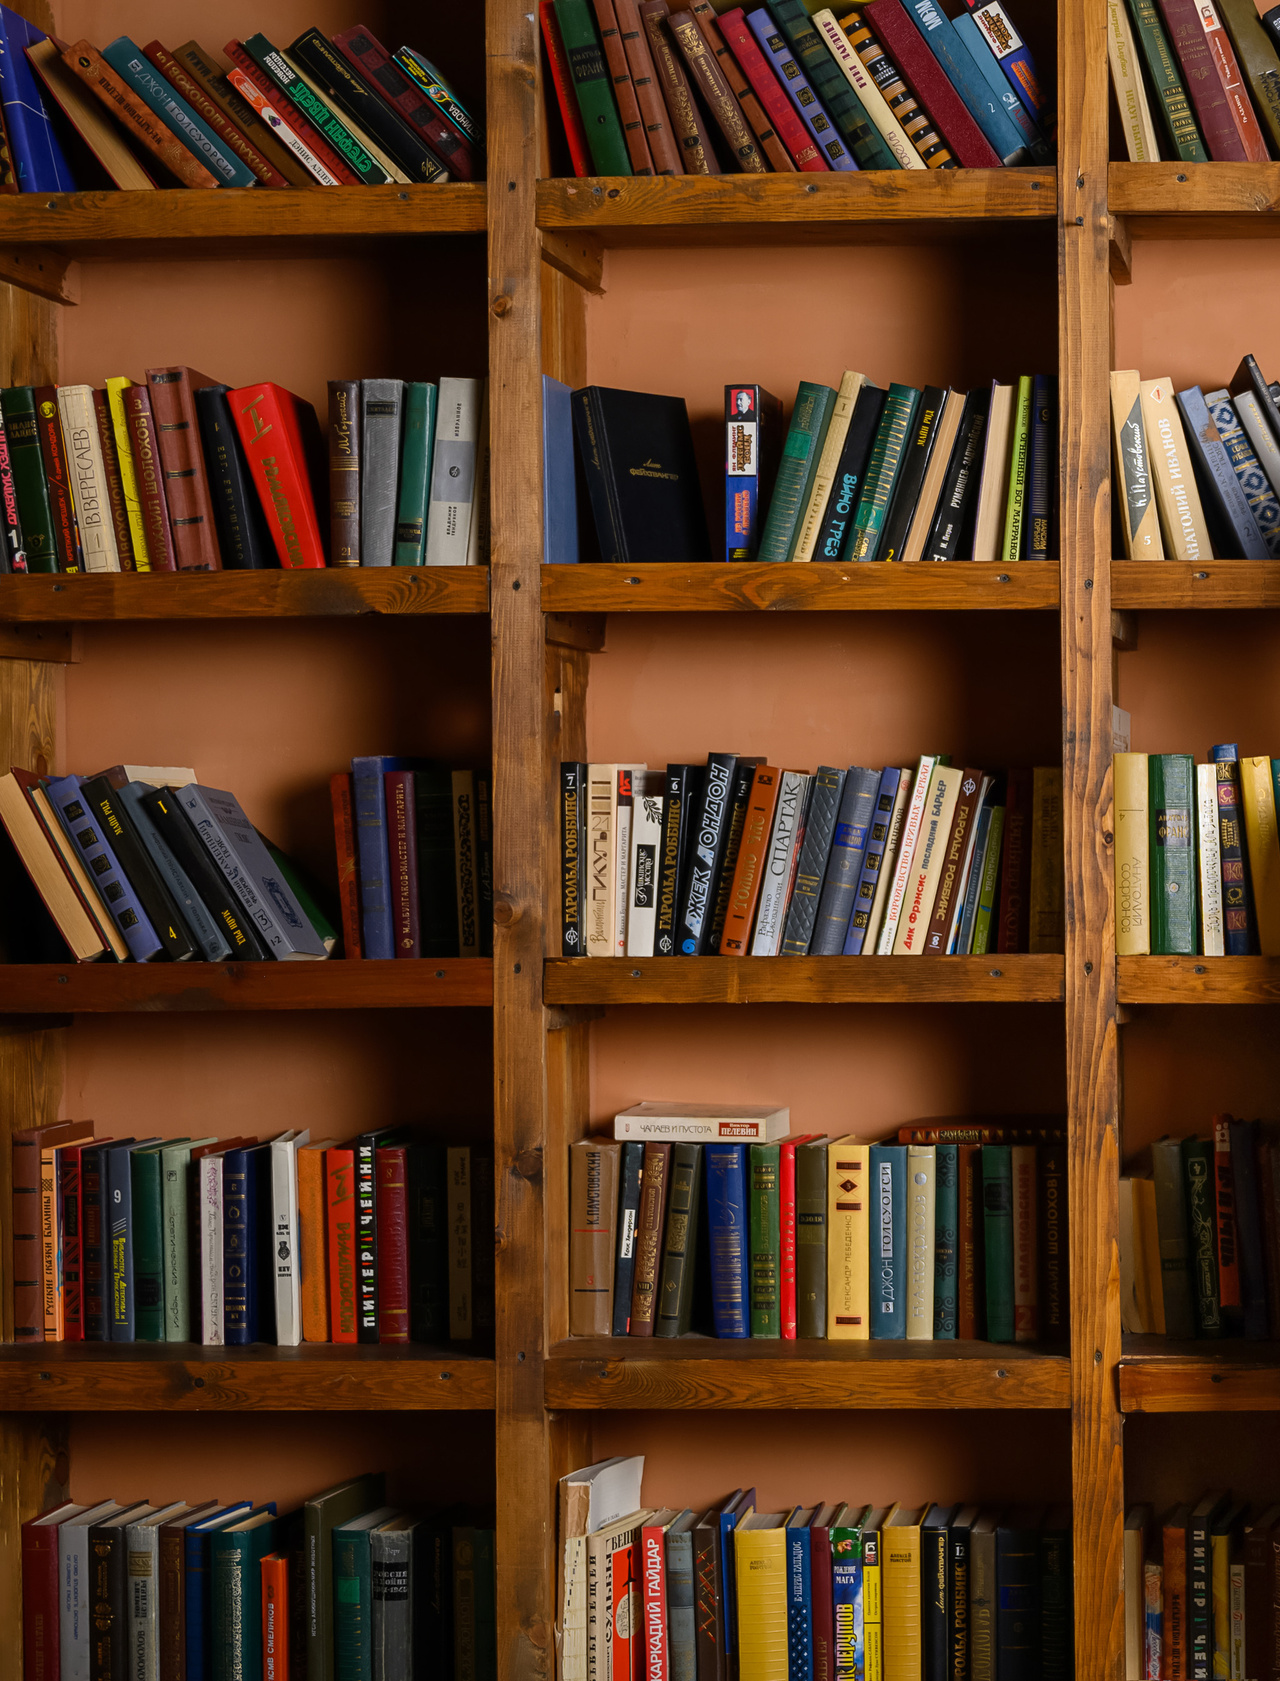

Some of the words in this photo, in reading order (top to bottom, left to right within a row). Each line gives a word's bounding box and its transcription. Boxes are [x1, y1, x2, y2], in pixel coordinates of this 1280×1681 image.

[135, 67, 175, 106] ДЖОН
[169, 104, 233, 177] ГОЛСУОРСИ
[286, 78, 331, 126] ЦВЕЙГ
[220, 127, 273, 181] МИХАИЛ
[288, 137, 314, 163] ДЭНИС
[322, 118, 374, 174] СТЕФАН
[134, 418, 157, 494] ШОЛОХОВ
[1157, 418, 1182, 478] ИВАНОВ
[835, 472, 857, 513] ВИНО
[1171, 484, 1200, 561] АНАТОЛИЙ
[148, 499, 168, 564] МИХАИЛ
[823, 520, 846, 556] ГРЕЗ
[565, 791, 577, 857] РОББИНС
[695, 762, 730, 867] ЛОНДОН
[768, 780, 800, 876] СПАРТАК
[931, 780, 947, 816] БАРЬЕР
[665, 799, 680, 865] РОББИНС
[888, 850, 911, 921] КОРОЛЕВСТВО
[904, 804, 921, 848] КРИВЫХ
[914, 764, 929, 801] ЗЕРКАЛ
[948, 804, 969, 860] ГАРОЛЬД
[565, 860, 578, 922] ГАРОЛЬД
[592, 831, 606, 900] ПИКУЛЬ
[659, 867, 676, 929] ГАРОЛЬД
[907, 873, 927, 923] Фрэнсис
[935, 863, 956, 920] РОББИНС
[1120, 863, 1131, 932] СОФРОНОВ
[1131, 856, 1142, 925] АНАТОЛИЙ
[220, 908, 238, 931] МАЙН
[231, 929, 246, 946] РИД
[683, 865, 711, 938] ДЖЕК
[902, 926, 916, 949] Дик
[358, 1145, 372, 1224] ЧЕЙНИ
[586, 1152, 600, 1224] К.ПАУСТОВСКИЙ
[881, 1166, 891, 1251] ГОЛСУОРСИ
[360, 1251, 374, 1326] ПИТЕР
[881, 1259, 894, 1299] ДЖОН
[646, 1538, 660, 1595] ГАЙДАР
[954, 1562, 965, 1627] РОББИНС
